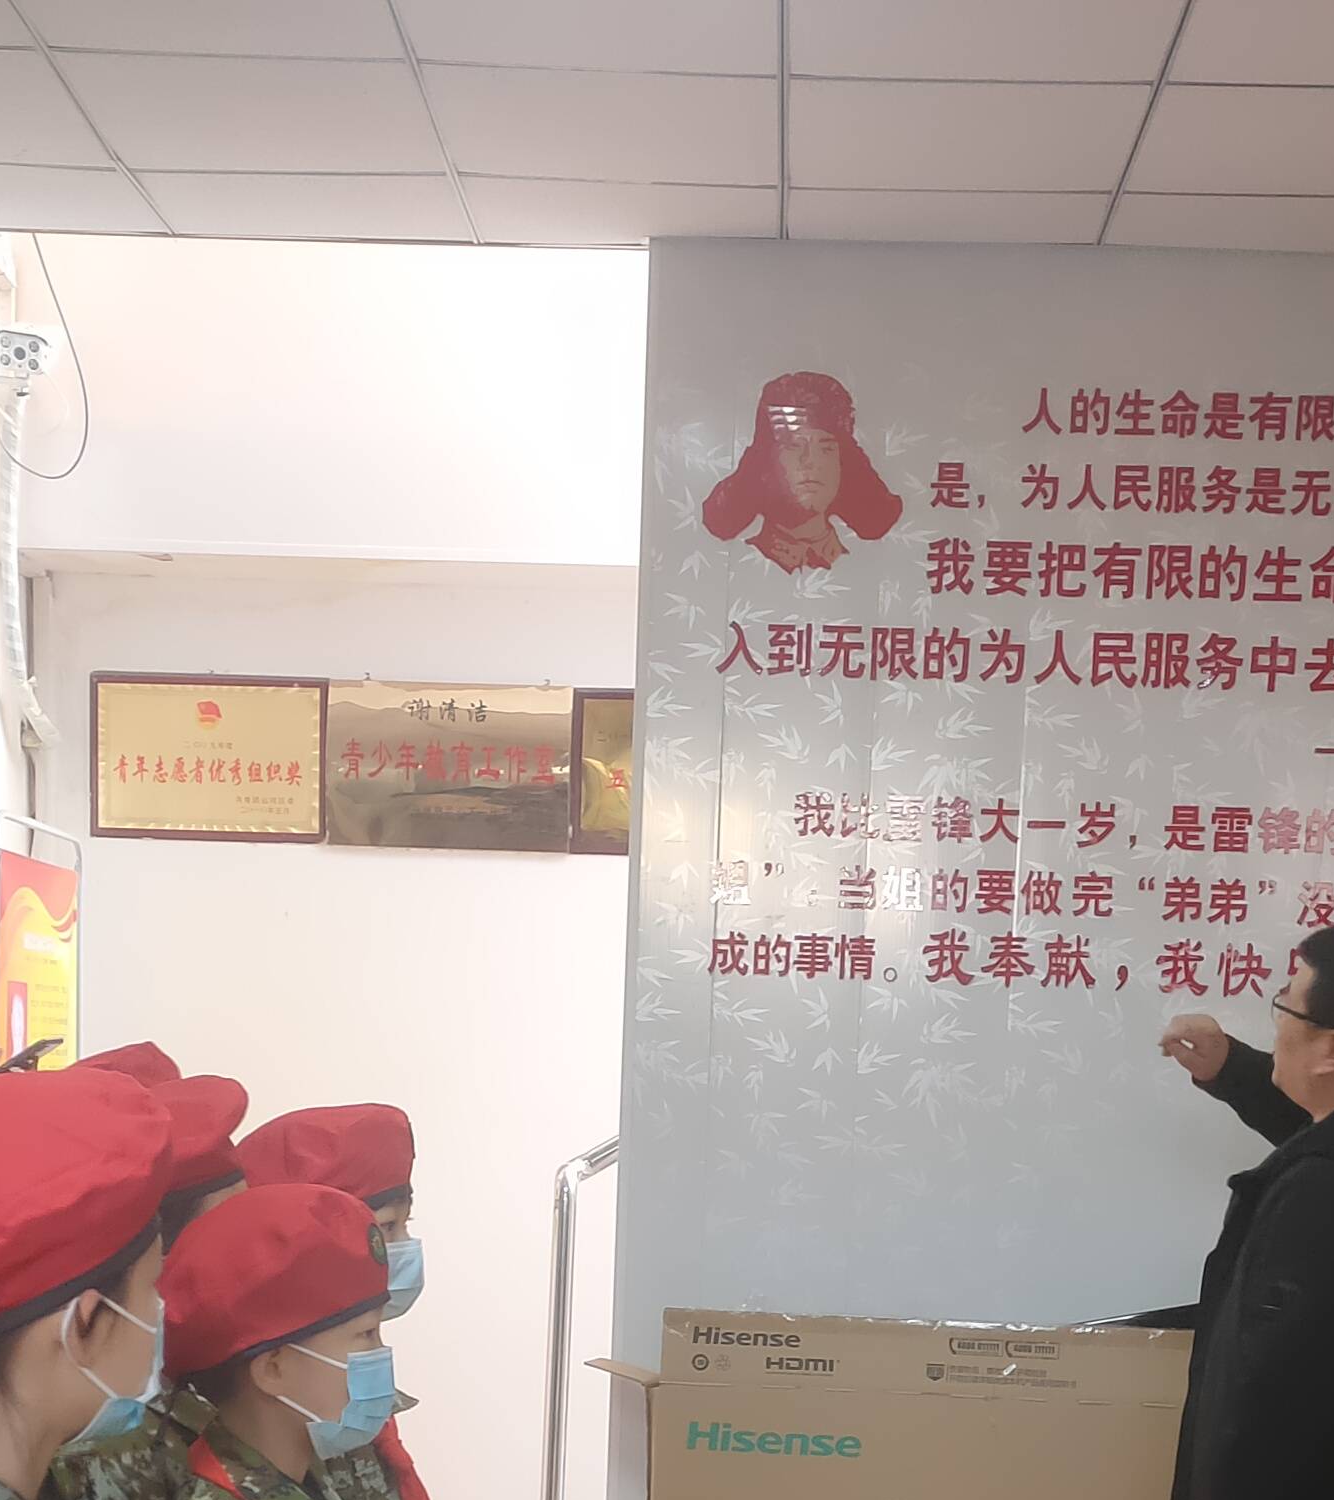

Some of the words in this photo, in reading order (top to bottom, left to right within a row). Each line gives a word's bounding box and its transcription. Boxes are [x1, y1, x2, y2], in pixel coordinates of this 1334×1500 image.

[408, 698, 489, 724] 谢清洁
[113, 753, 303, 787] 青年志愿者优秀组织奖
[340, 738, 556, 786] 青少年教育工作室
[708, 927, 1304, 1000] 成的事情。我奉献，我快
[692, 1325, 802, 1349] Hisense
[766, 1356, 837, 1374] HDMI
[686, 1420, 862, 1459] Hisense
